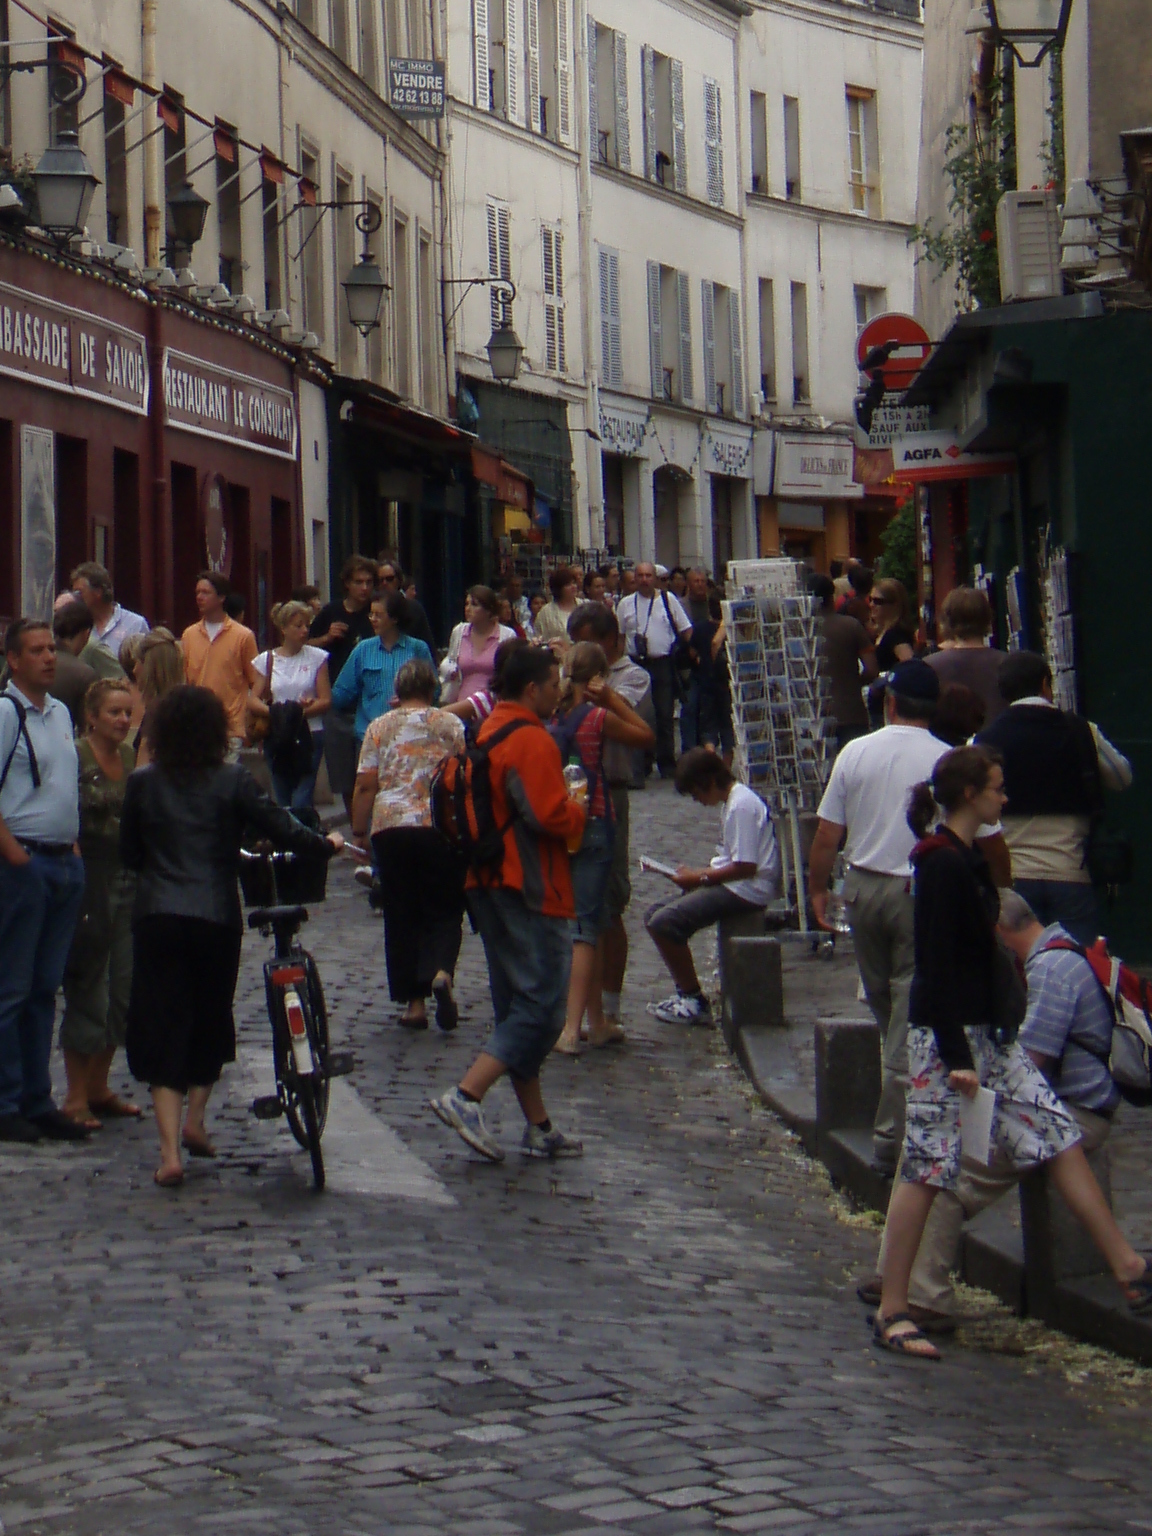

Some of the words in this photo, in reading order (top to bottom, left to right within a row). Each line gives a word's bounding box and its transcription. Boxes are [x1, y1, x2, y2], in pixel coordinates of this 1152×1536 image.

[393, 71, 443, 91] VENDRE
[405, 89, 417, 104] 62
[419, 91, 430, 105] 13
[431, 92, 443, 106] 88
[79, 331, 96, 379] DE
[105, 339, 145, 395] SAVOIE
[164, 366, 228, 423] RESTAURANT
[232, 387, 245, 428] LE
[248, 394, 294, 442] CONSULAT
[883, 411, 902, 421] 15h
[872, 423, 900, 434] SAUF
[905, 423, 928, 433] AUX
[903, 447, 943, 462] AGFA
